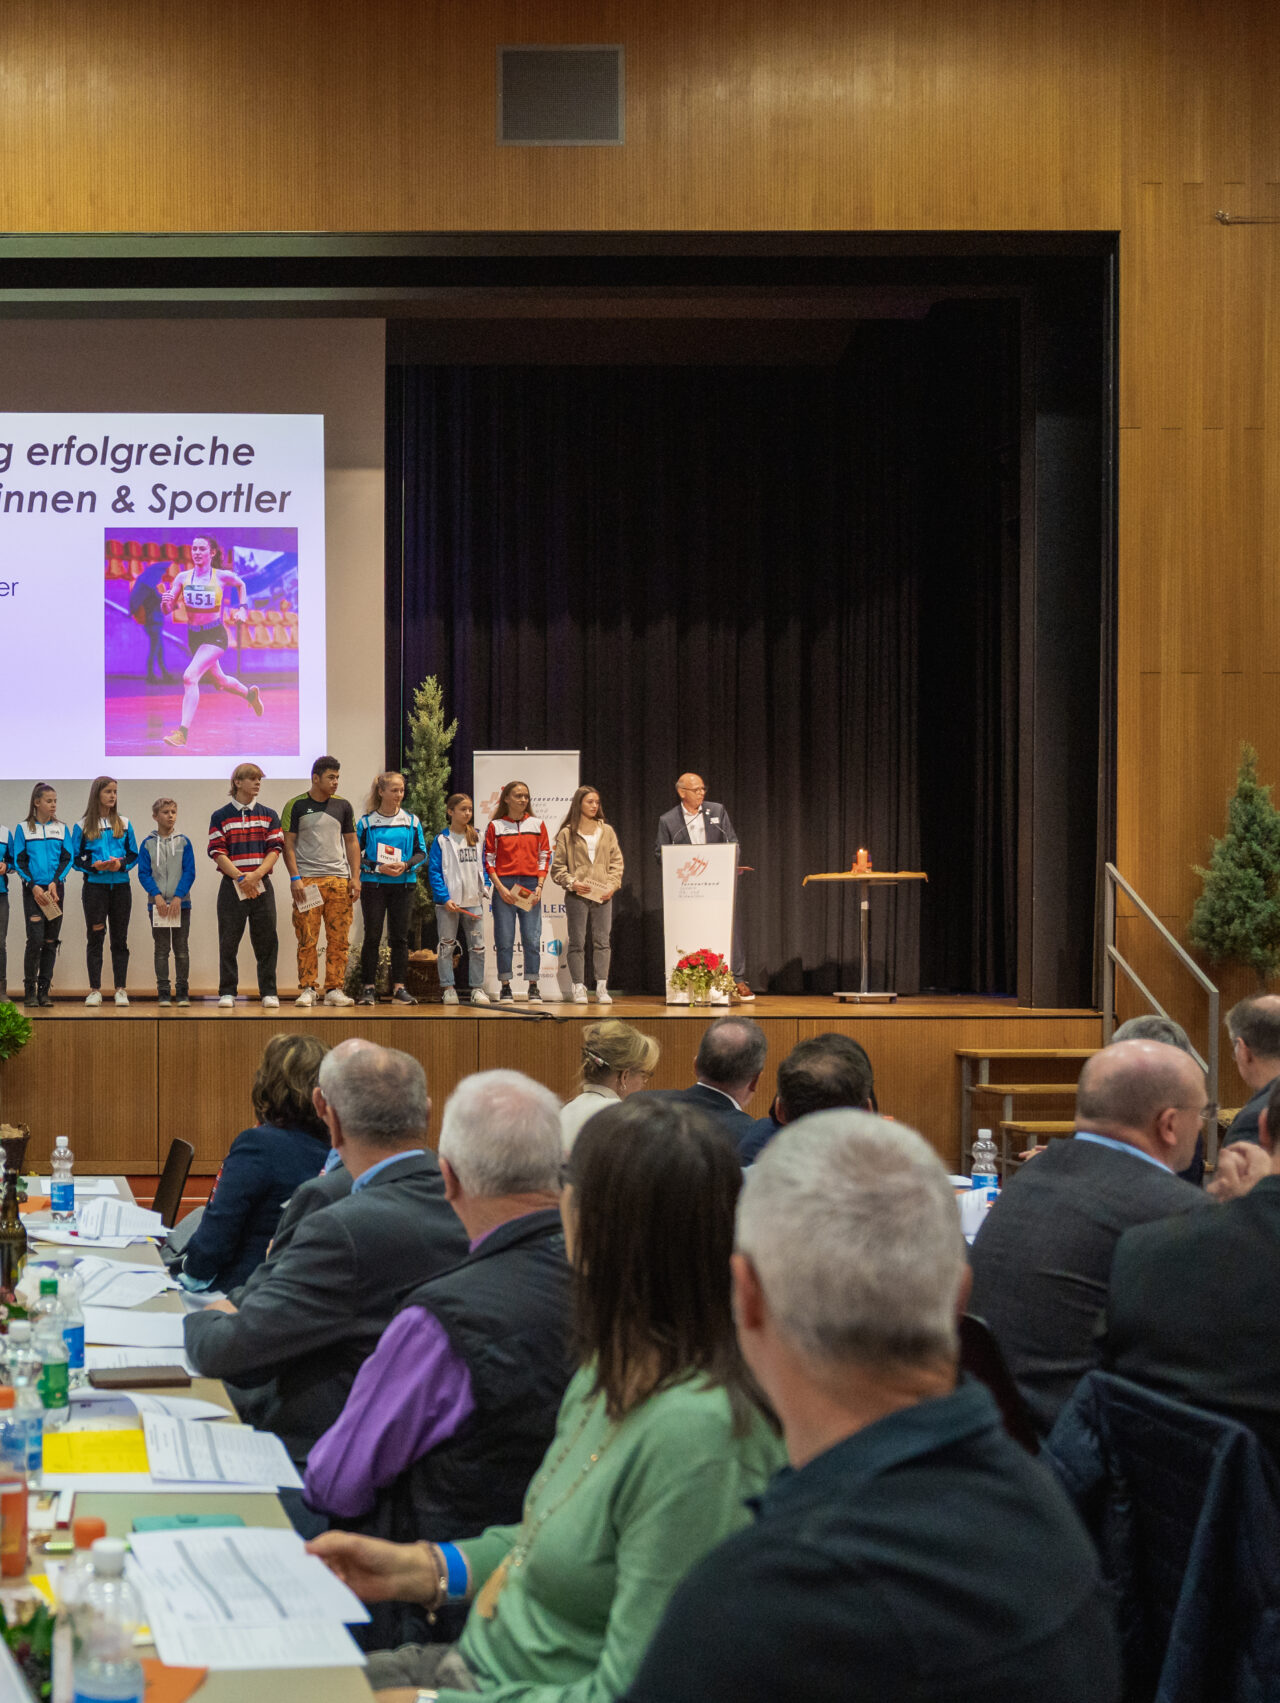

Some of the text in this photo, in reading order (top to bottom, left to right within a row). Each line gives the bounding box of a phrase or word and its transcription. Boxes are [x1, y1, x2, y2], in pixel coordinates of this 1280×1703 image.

[26, 434, 255, 474] erfolgreiche
[111, 484, 136, 514] &
[147, 482, 292, 520] Sportler
[186, 592, 213, 606] 151
